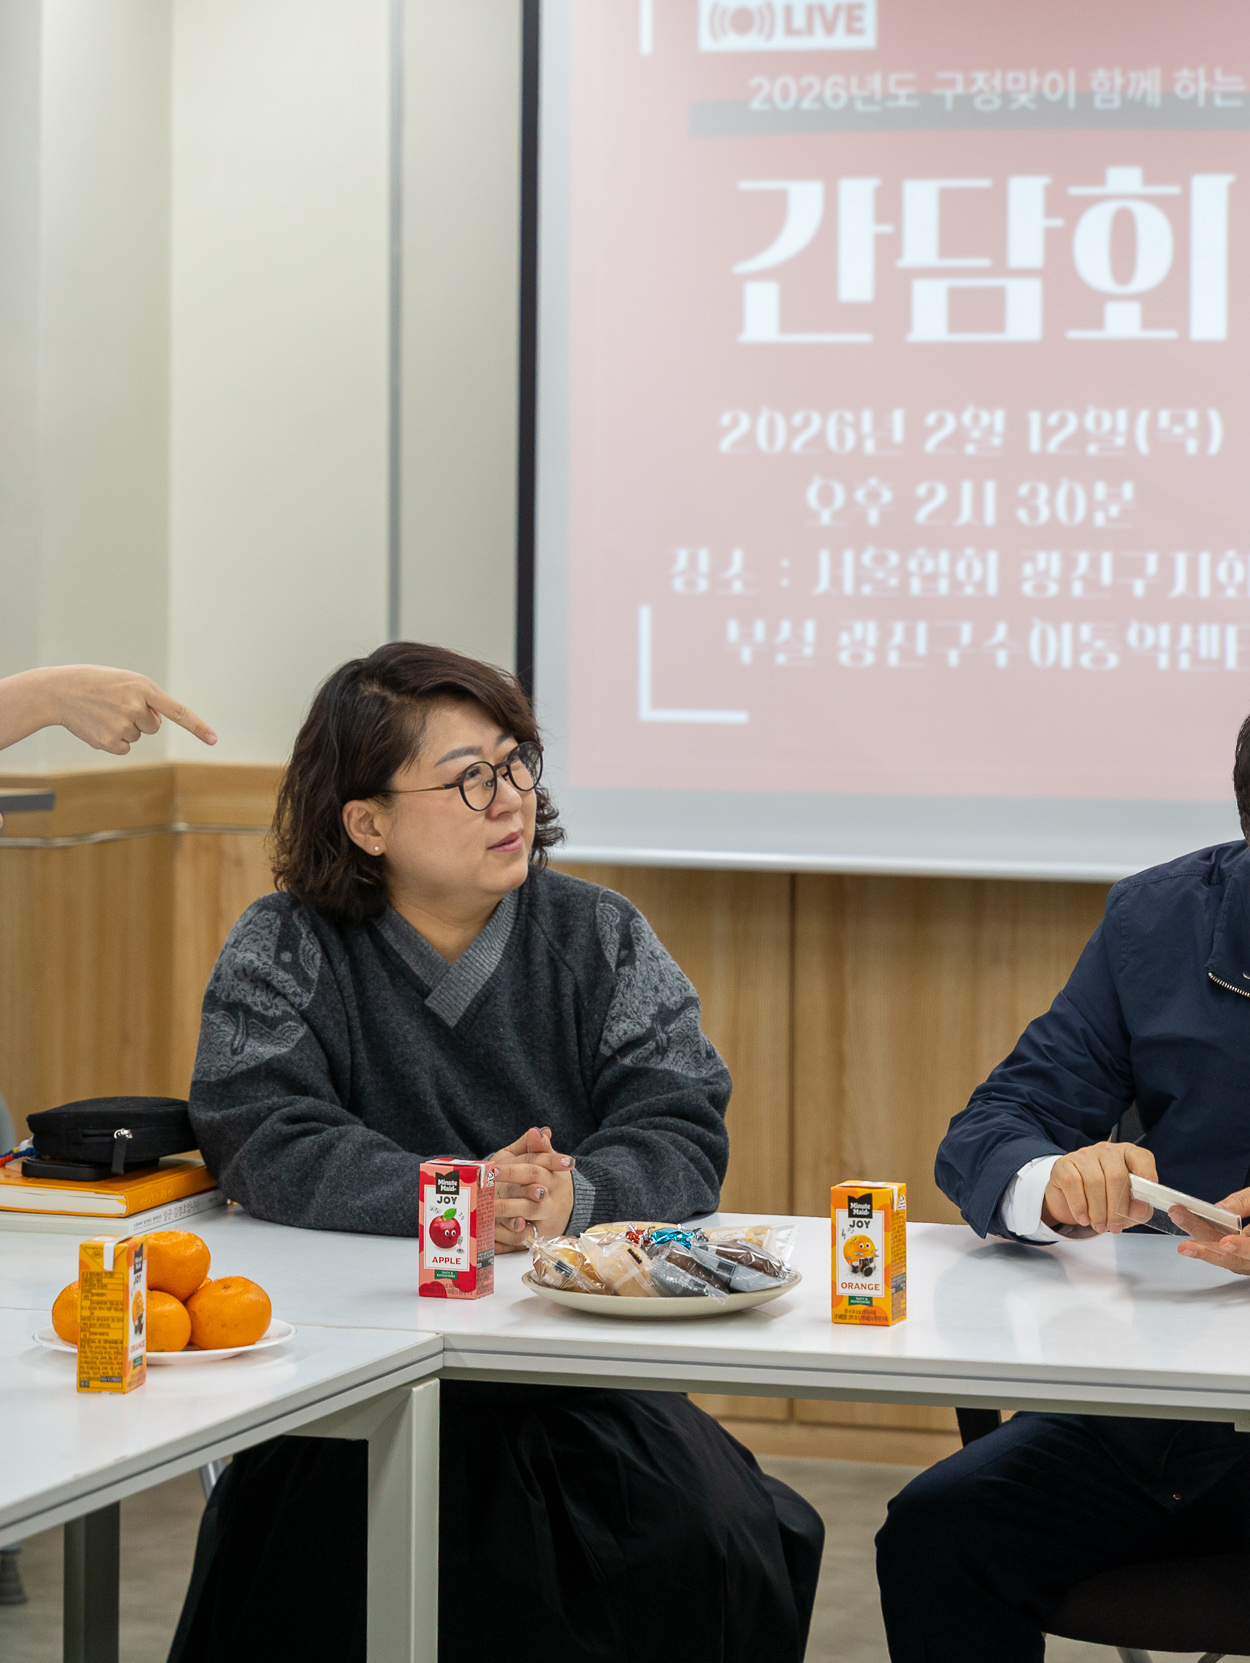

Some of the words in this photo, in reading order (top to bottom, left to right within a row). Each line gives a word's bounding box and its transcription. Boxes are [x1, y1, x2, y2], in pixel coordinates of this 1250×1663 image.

[782, 2, 866, 38] LIVE
[750, 70, 921, 112] 2026년도
[932, 66, 1076, 112] 구정맞이
[1089, 65, 1162, 110] 함께
[1173, 64, 1248, 108] 하는
[731, 165, 1236, 343] 간담회
[718, 406, 906, 456] 2026년
[923, 405, 1006, 456] 2월
[1026, 406, 1224, 456] 12일(목)
[804, 475, 895, 527] 오후
[914, 479, 997, 527] 2시
[1015, 477, 1136, 528] 30분
[669, 547, 761, 596] 장소
[811, 545, 1000, 597] 서울협회
[436, 1195, 458, 1205] JOY
[850, 1202, 871, 1210] Minute
[852, 1208, 870, 1216] Maid
[849, 1219, 871, 1229] JOY
[432, 1256, 462, 1265] APPLE
[840, 1281, 881, 1291] ORANGE
